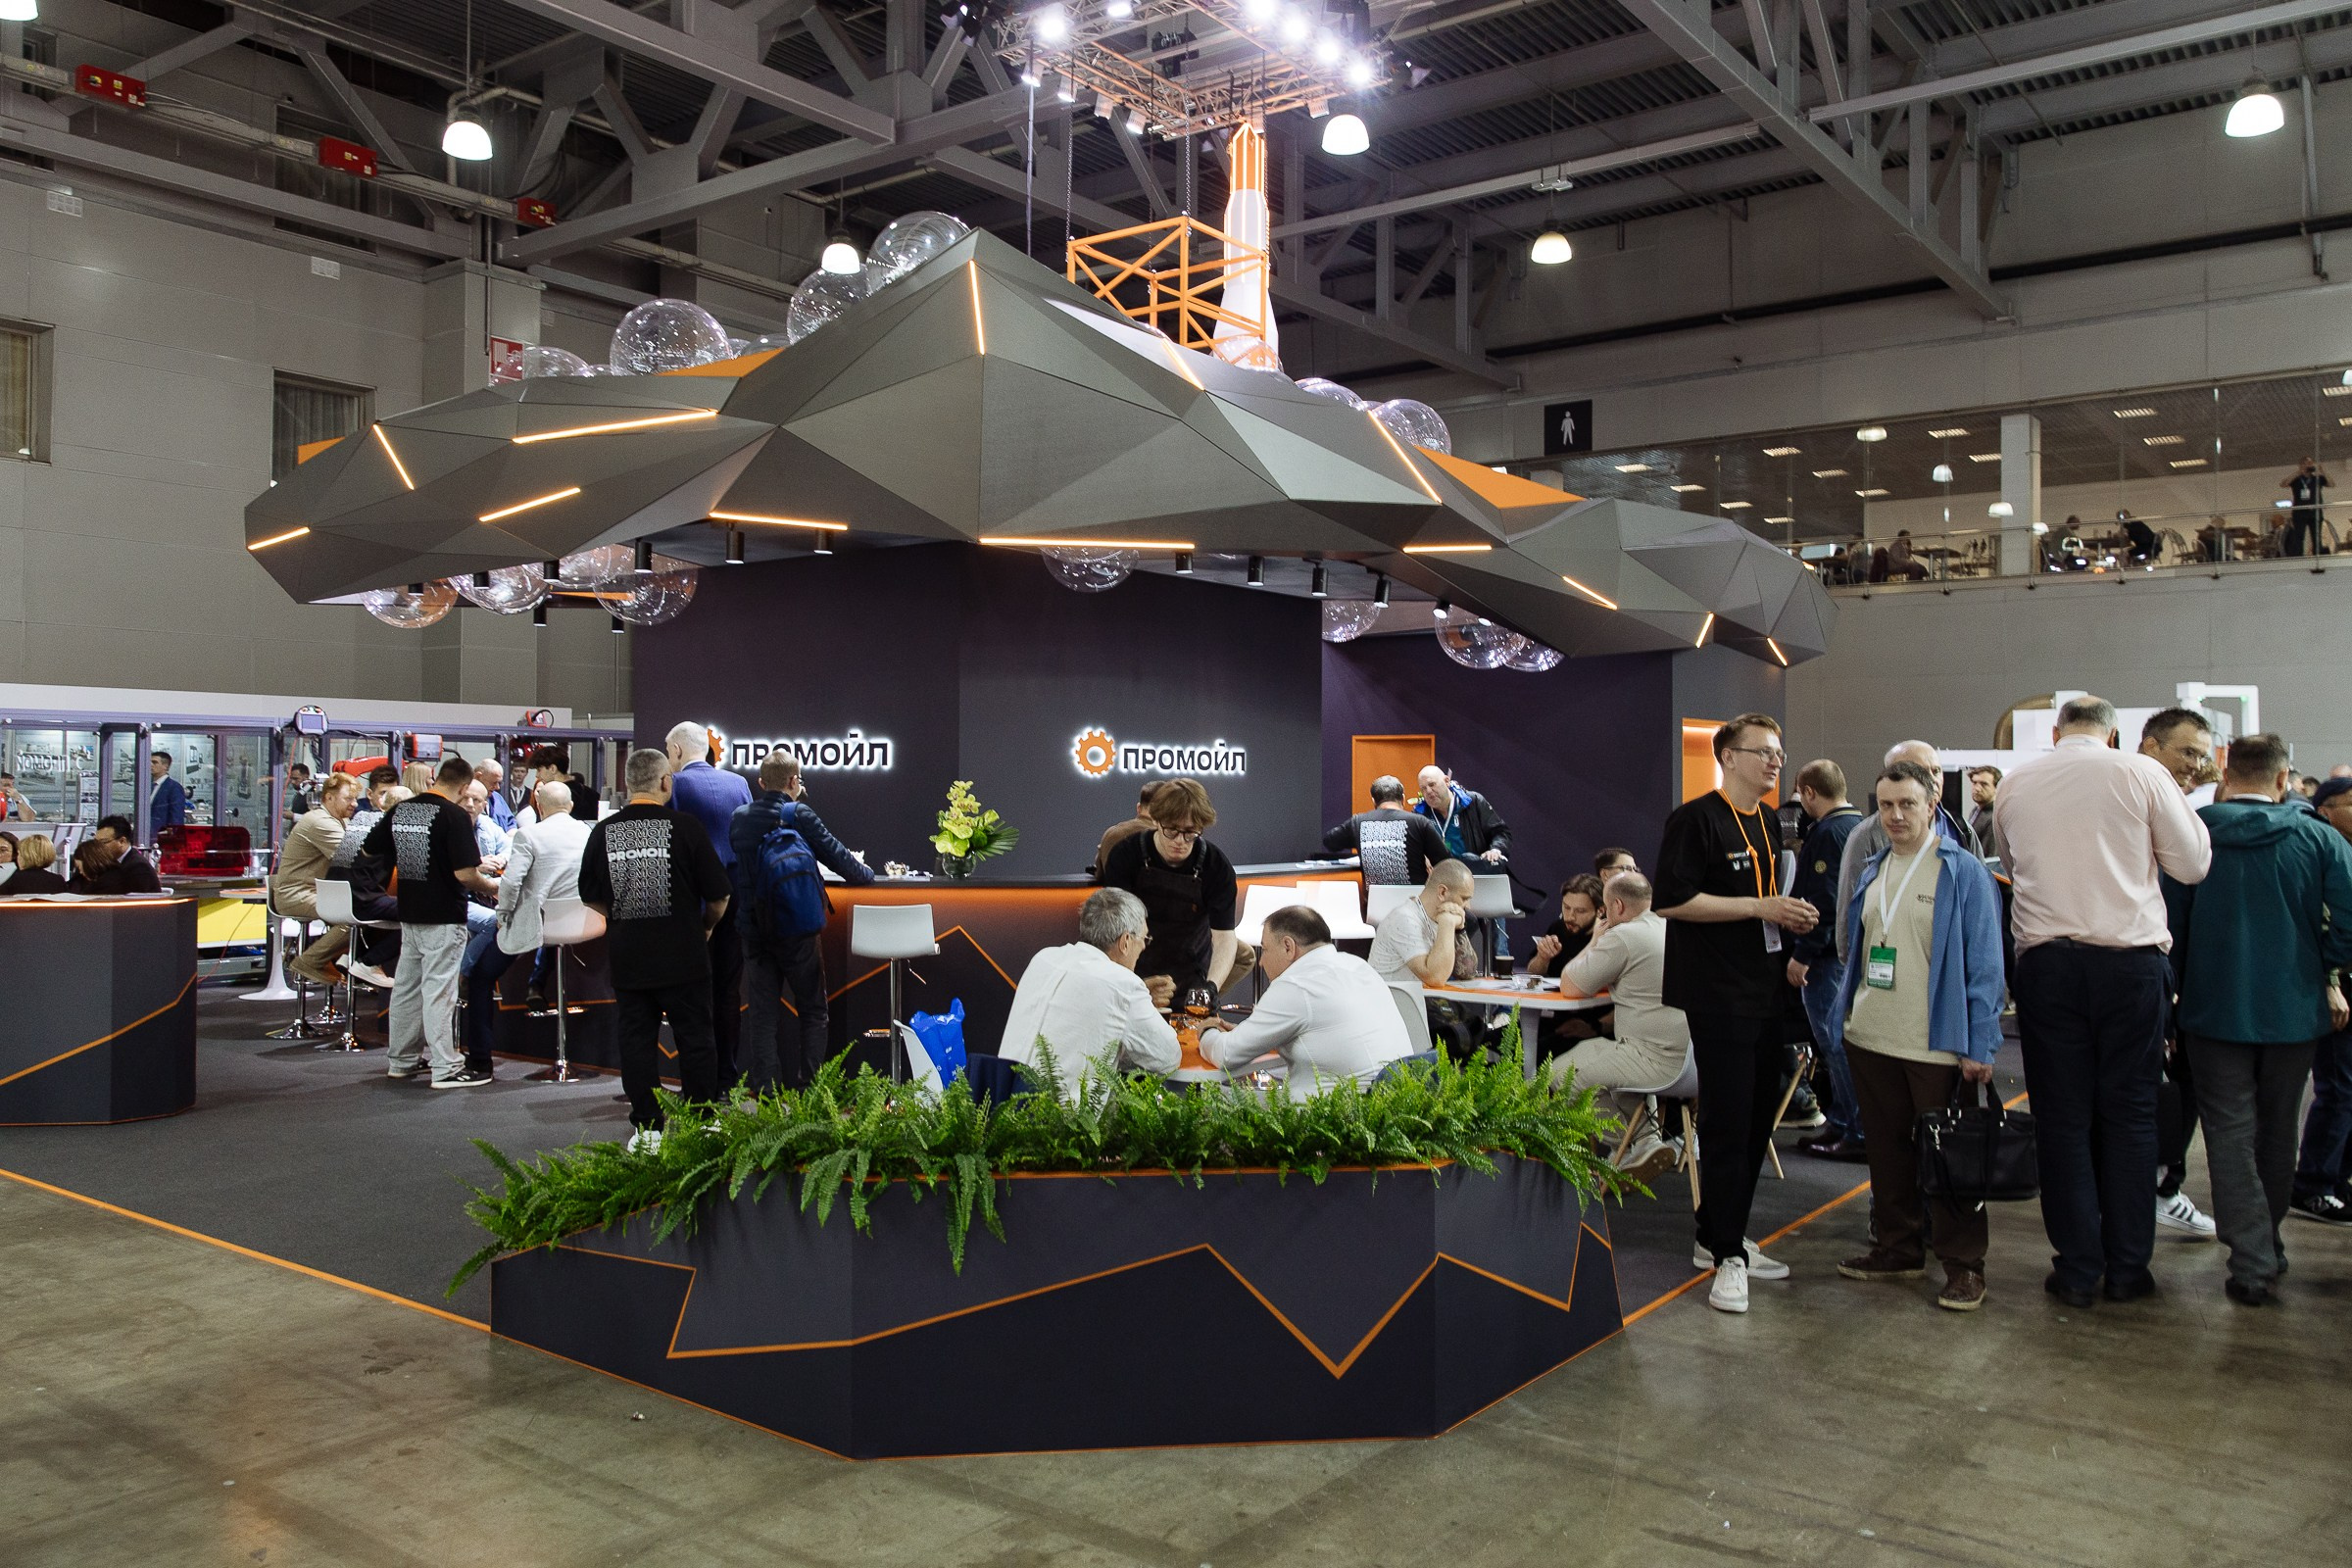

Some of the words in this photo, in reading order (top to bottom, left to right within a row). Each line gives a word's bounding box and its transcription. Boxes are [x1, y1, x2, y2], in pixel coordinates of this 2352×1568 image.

[732, 733, 888, 765] ПРМОЙЛ
[1123, 743, 1246, 771] ПРОМОЙЛ
[392, 824, 430, 834] PROMOIL
[606, 819, 673, 833] PROMOIL
[606, 828, 671, 843] PROMOIL
[607, 838, 670, 852] PROMOIL
[608, 848, 671, 862] PROMOIL
[609, 858, 671, 873] PROMOIL
